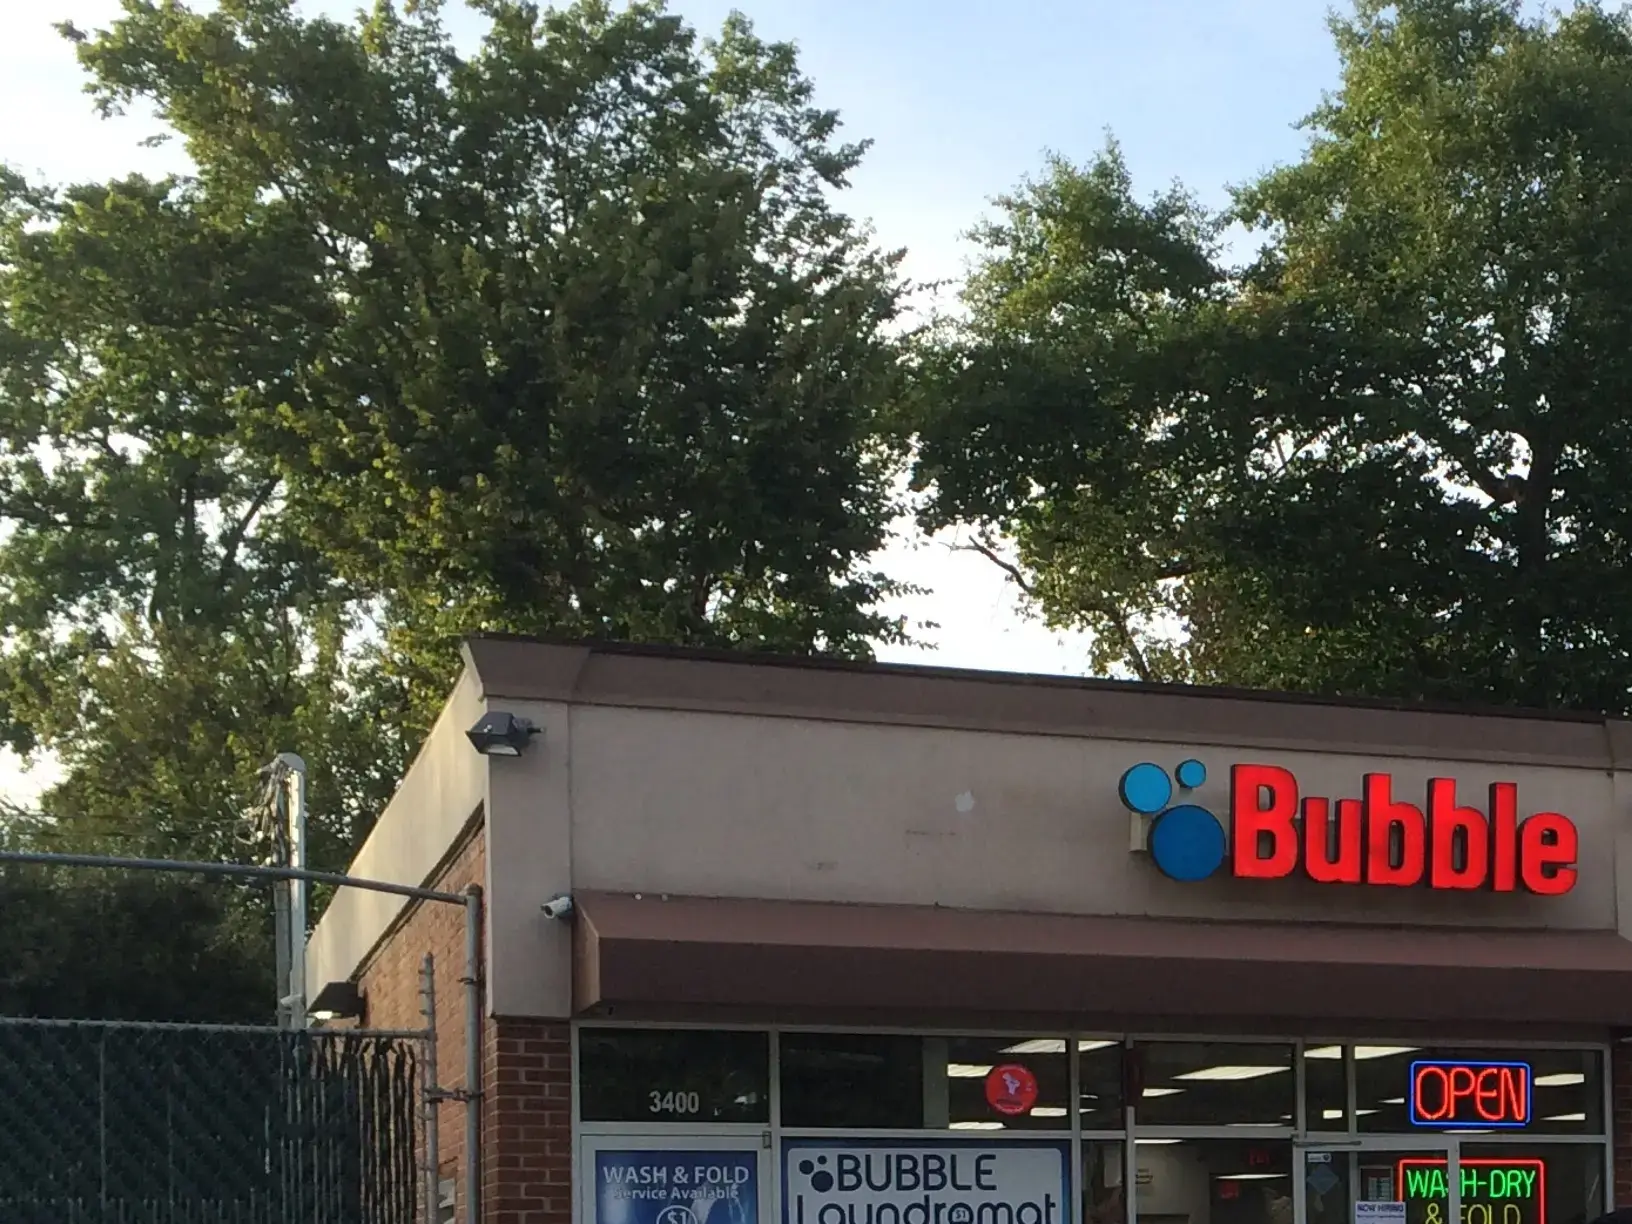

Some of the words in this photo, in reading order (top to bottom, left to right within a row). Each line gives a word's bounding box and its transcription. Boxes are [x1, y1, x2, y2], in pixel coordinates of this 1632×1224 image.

[1230, 762, 1579, 897] Bubble
[649, 1091, 700, 1114] 3400
[1415, 1066, 1525, 1121] OPEN
[603, 1166, 667, 1184] WASH
[673, 1166, 689, 1184] &
[695, 1166, 749, 1184] FOLD
[837, 1154, 998, 1192] BUBBLE
[615, 1187, 667, 1200] Service
[671, 1186, 740, 1200] Available
